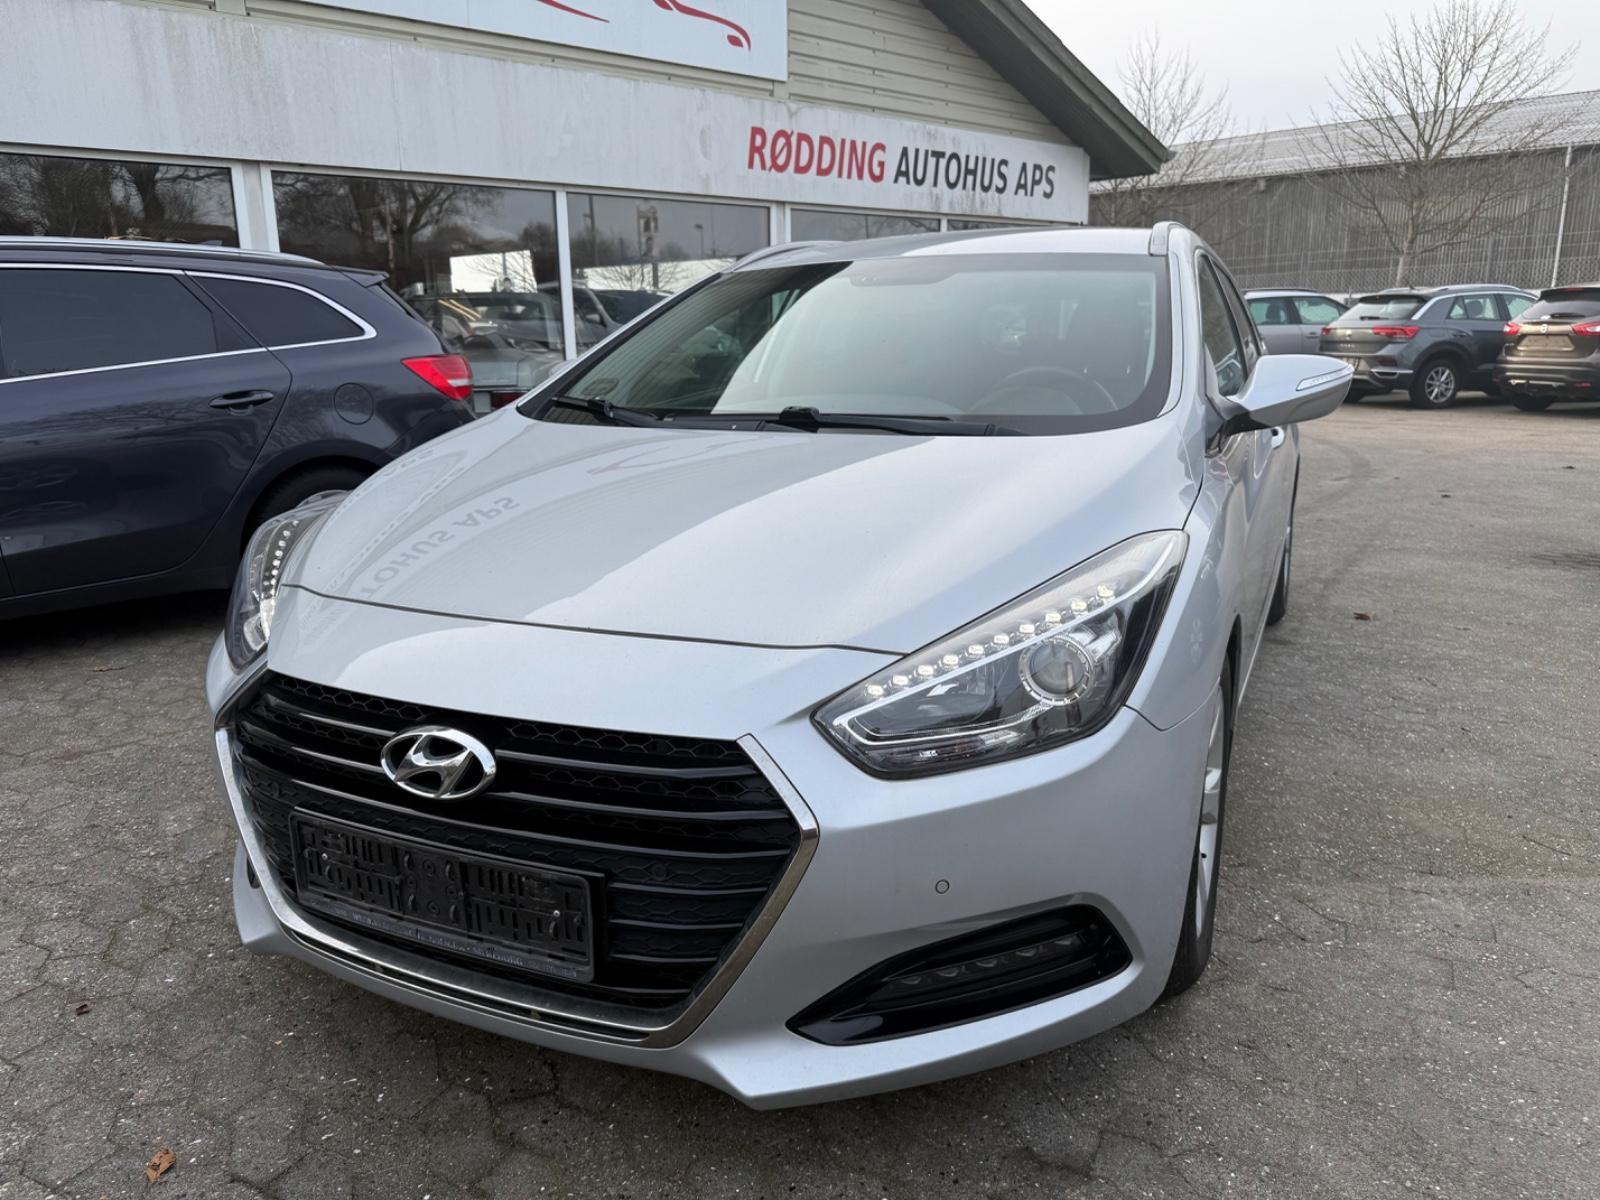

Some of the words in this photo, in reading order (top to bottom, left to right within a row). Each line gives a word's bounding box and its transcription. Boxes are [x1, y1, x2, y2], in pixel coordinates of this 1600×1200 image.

[748, 126, 886, 183] RØDDING
[893, 146, 1008, 195] AUTOHUS
[1014, 161, 1056, 199] APS
